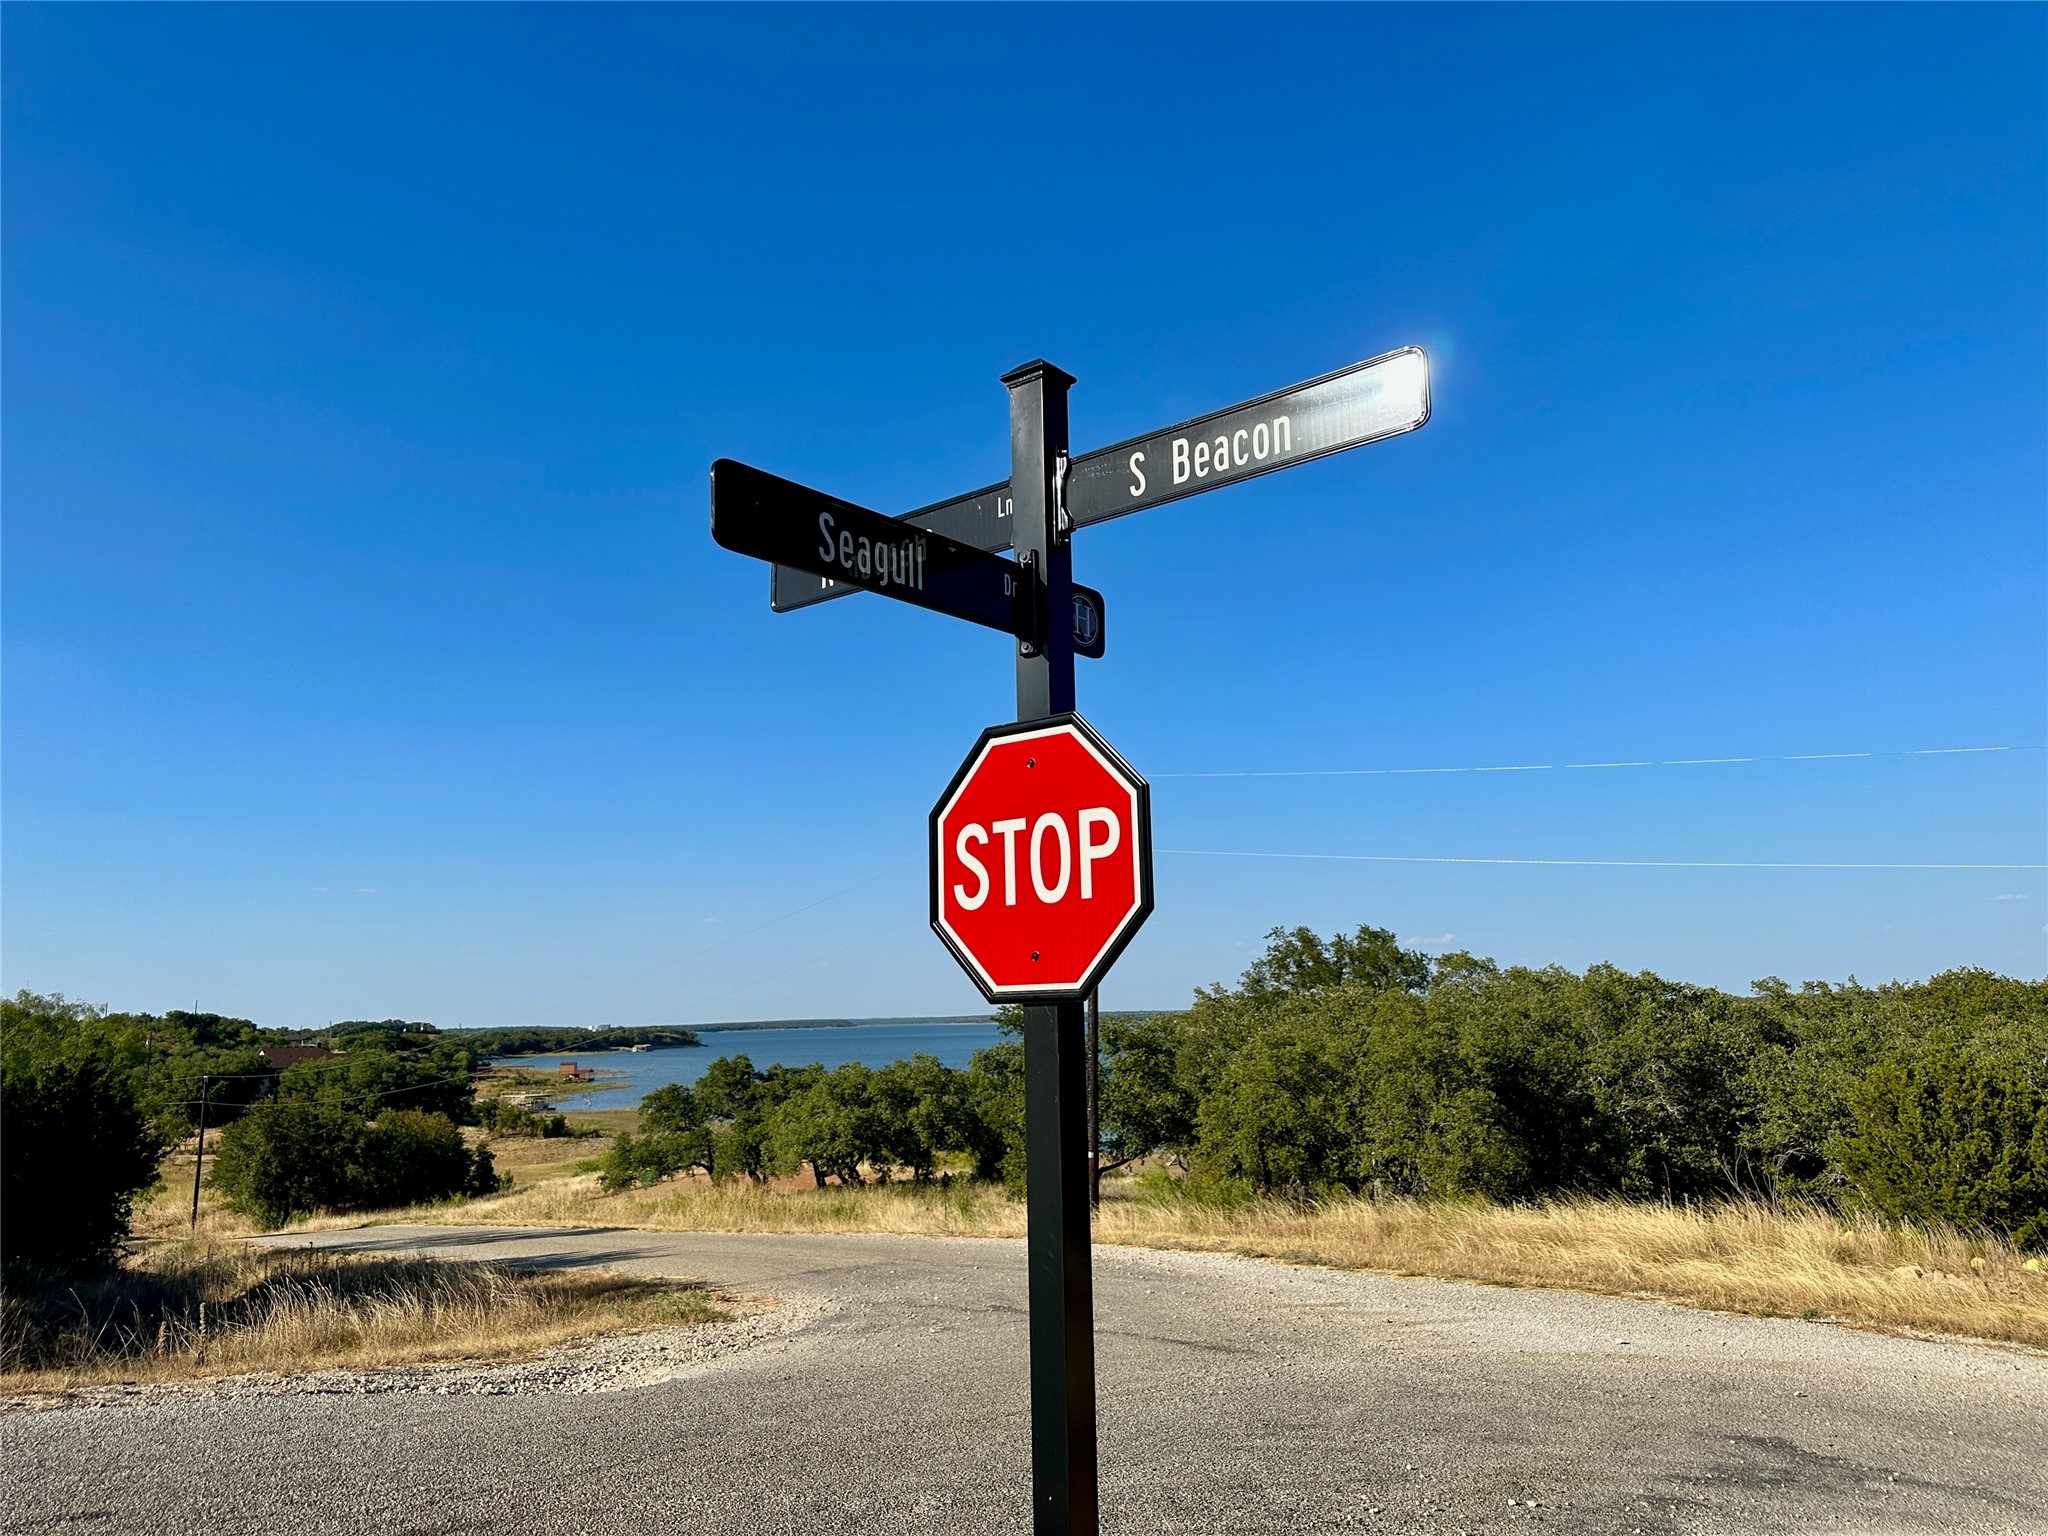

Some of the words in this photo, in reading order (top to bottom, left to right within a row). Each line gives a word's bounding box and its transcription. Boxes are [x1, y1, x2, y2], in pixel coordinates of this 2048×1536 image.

[1129, 451, 1147, 497] S
[1172, 415, 1292, 485] Beacon
[997, 497, 1013, 518] Ln
[819, 511, 923, 591] Seagull
[1004, 573, 1019, 598] Dr
[1072, 601, 1092, 638] H
[953, 806, 1121, 911] STOP
